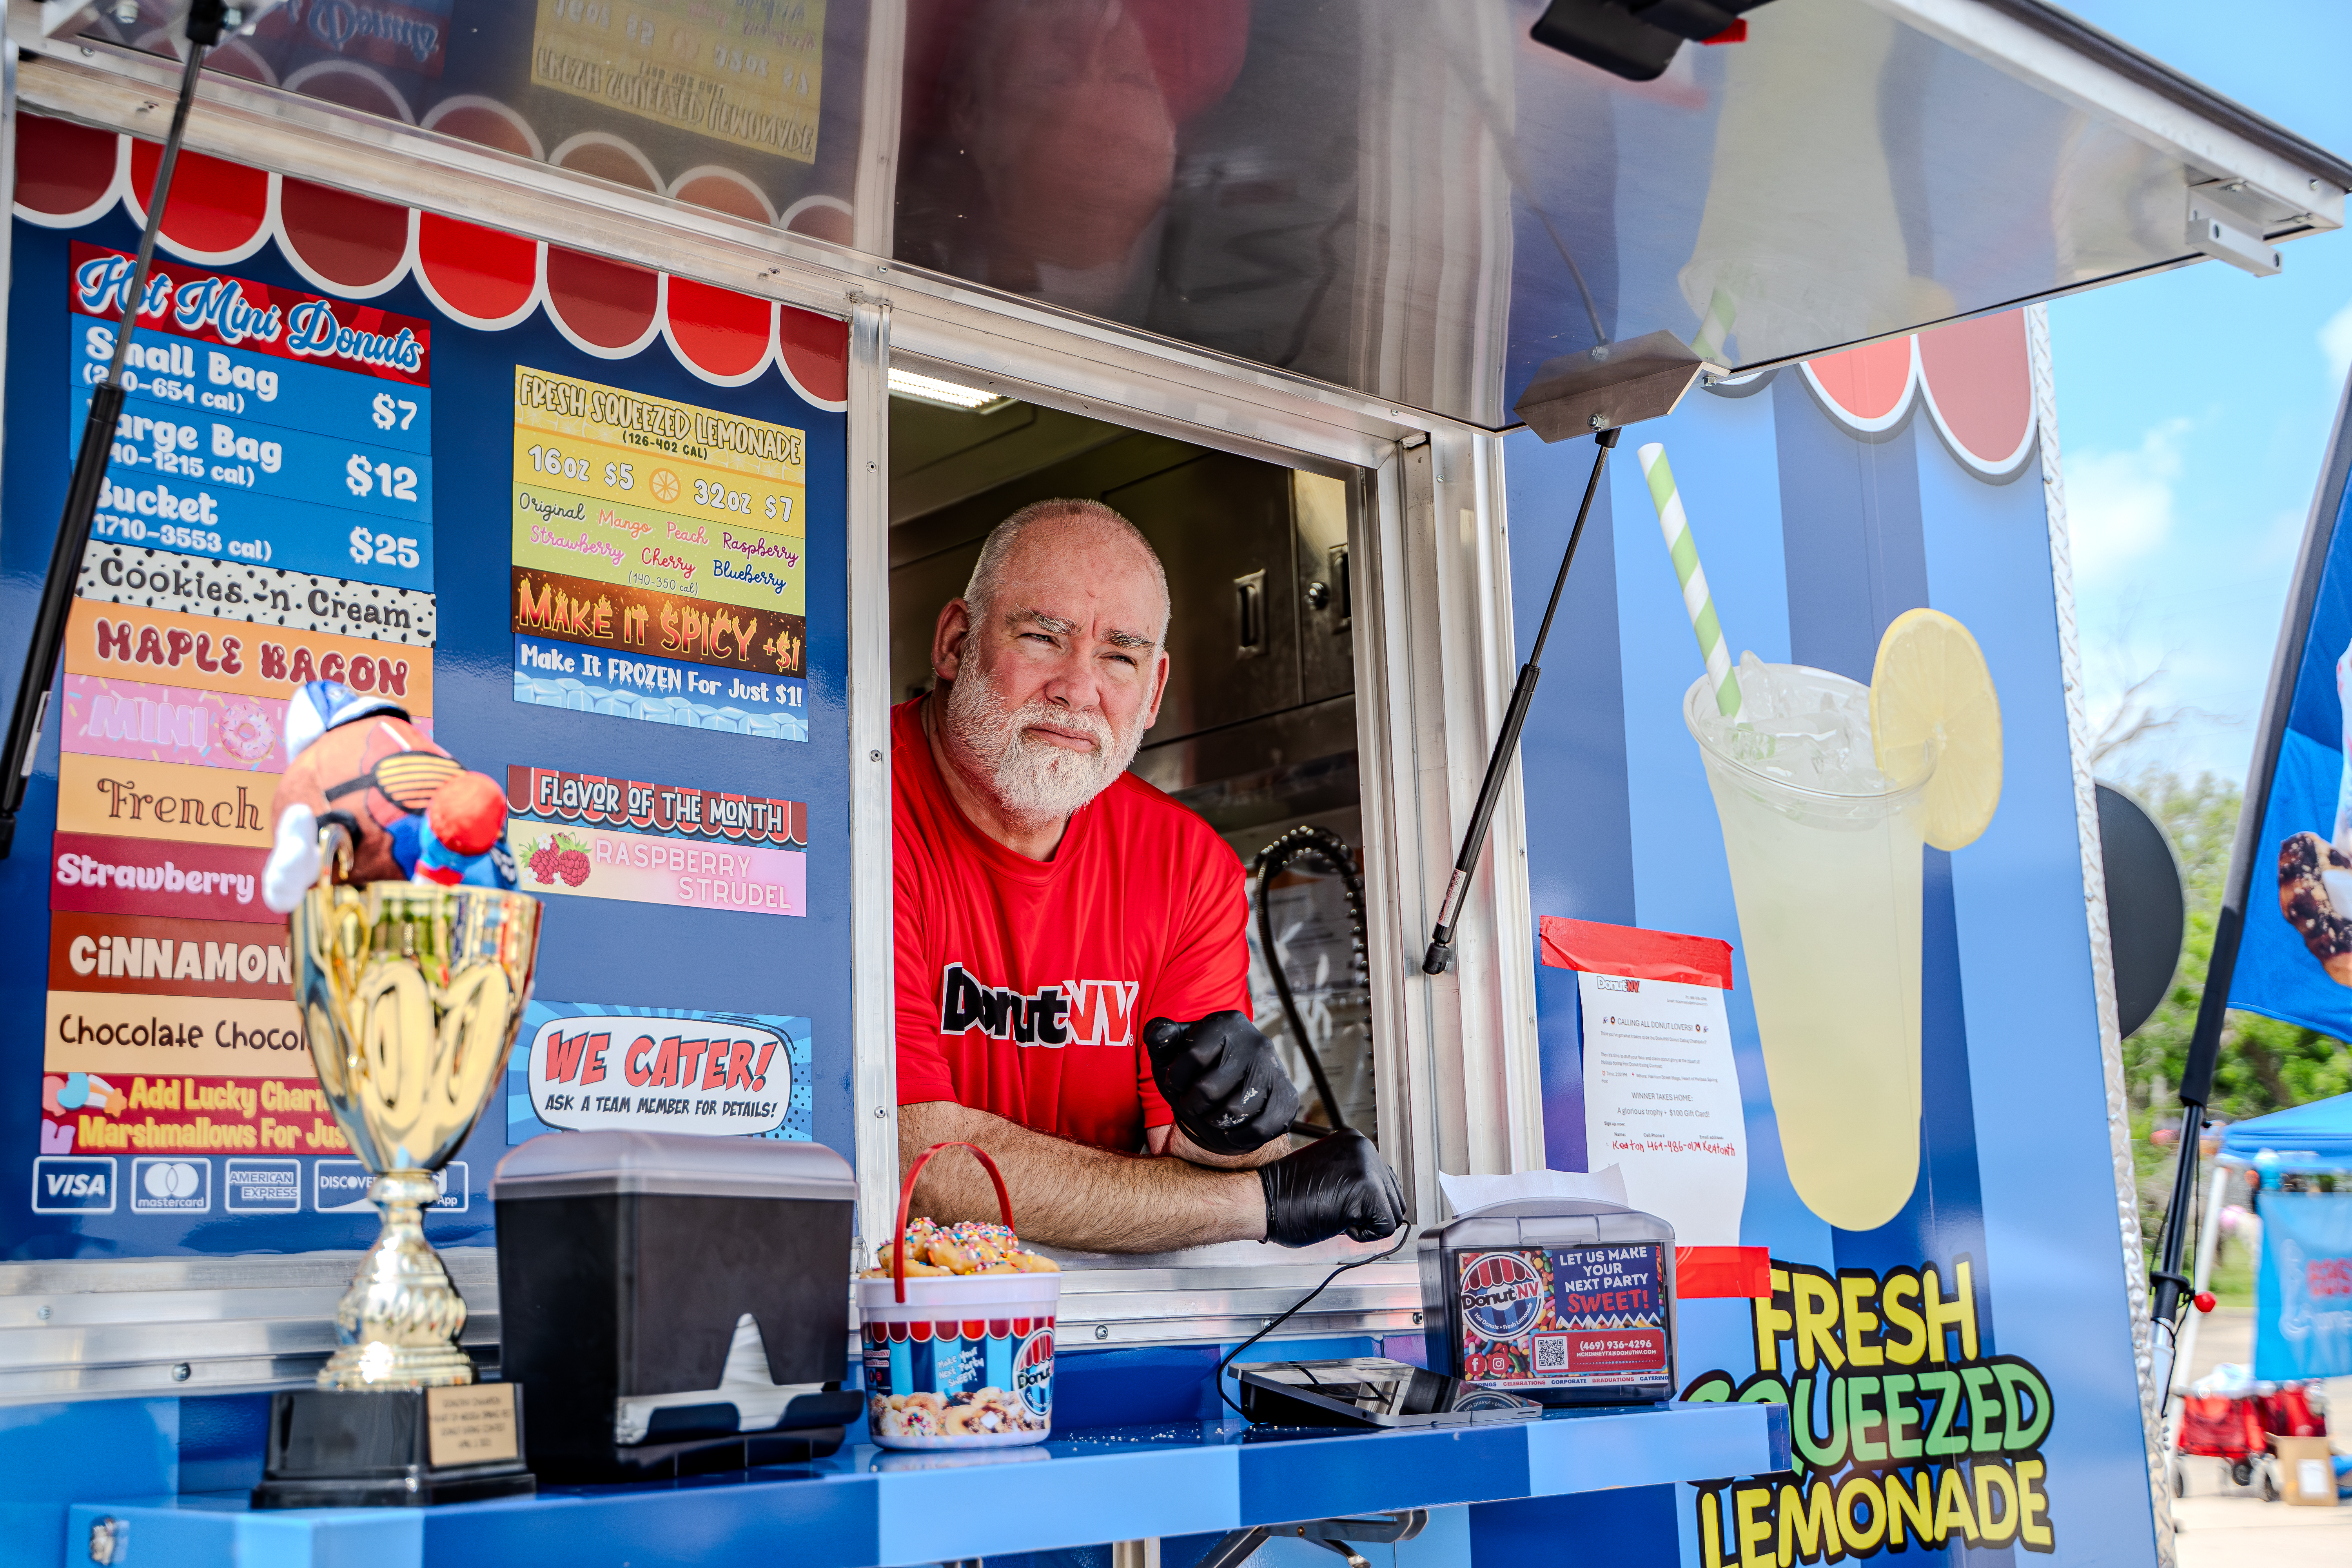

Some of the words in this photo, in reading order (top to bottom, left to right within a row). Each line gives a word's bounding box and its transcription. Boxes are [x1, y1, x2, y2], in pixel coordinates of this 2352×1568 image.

[75, 254, 173, 319] Ht
[176, 277, 283, 344] Mini
[287, 299, 425, 374] Donuts
[83, 362, 195, 404] (20-654
[201, 392, 245, 414] cal)
[208, 351, 278, 401] Bag
[372, 393, 418, 430] $7
[521, 374, 586, 418] FRESH
[591, 393, 691, 439] SQUEEZED
[696, 412, 801, 465] LEMONADE
[87, 399, 199, 453] arge
[212, 423, 283, 473] Bag
[623, 430, 678, 454] (126-402
[682, 444, 708, 460] CAL)
[110, 443, 205, 477] 40-1215
[211, 457, 255, 488] cal)
[346, 454, 418, 503] $12
[604, 461, 634, 490] $5
[765, 495, 793, 523] $7
[94, 513, 222, 553] 1710-3553
[227, 539, 273, 563] cal)
[349, 526, 420, 568] $25
[519, 492, 586, 522] Original
[599, 508, 652, 539] Mango
[667, 521, 708, 546] Peach
[723, 532, 799, 567] Raspberry
[530, 525, 625, 566] Strawberry
[642, 547, 696, 580] Cherry
[713, 559, 788, 595] Blueberry
[100, 557, 243, 604] Cookies
[307, 588, 412, 629] Cream
[629, 570, 676, 592] (140-350
[680, 582, 699, 596] cal)
[519, 577, 614, 640] MAKE
[624, 604, 649, 646] IT
[660, 600, 757, 662] SPICY
[762, 630, 801, 672] +$1
[94, 617, 243, 675] MAPLE
[260, 641, 409, 698] BACON
[521, 644, 575, 673] Make
[582, 655, 601, 678] It
[608, 659, 681, 693] FROZEN
[688, 671, 721, 696] For
[729, 678, 769, 704] Just
[775, 685, 802, 708] $1!
[88, 695, 209, 747] MINI
[97, 778, 265, 831] French
[628, 786, 653, 817] OF
[661, 791, 701, 823] THE
[710, 798, 783, 833] MONTH
[595, 839, 751, 878] RASPBERRY
[57, 853, 255, 904] Strawberry
[678, 877, 791, 909] STRUDEL
[1597, 976, 1640, 993] DonutNV
[59, 1013, 204, 1049] Chocolate
[215, 1020, 307, 1051] Chocol
[1618, 1018, 1639, 1026] CALLING
[1671, 1023, 1693, 1031] LOVERS!
[545, 1028, 611, 1086] WE
[624, 1034, 777, 1092] CATER!
[128, 1077, 177, 1109] Add
[184, 1079, 256, 1118] Lucky
[544, 1094, 574, 1111] ASK
[581, 1095, 590, 1111] A
[596, 1096, 631, 1114] TEAM
[637, 1098, 690, 1116] MEMBER
[695, 1098, 717, 1116] FOR
[722, 1101, 776, 1118] DETAILS!
[1622, 1107, 1644, 1116] glorious
[78, 1116, 257, 1148] Marshmallows
[261, 1118, 302, 1149] For
[306, 1118, 348, 1149] Jus
[45, 1174, 105, 1196] VISA
[229, 1171, 294, 1186] AMERICAN
[242, 1186, 298, 1200] EXPRESS
[320, 1176, 377, 1189] DISCOVE
[137, 1196, 204, 1208] mastercard
[437, 1195, 457, 1206] App
[1560, 1253, 1582, 1266] LET
[1586, 1251, 1604, 1263] US
[1608, 1247, 1647, 1261] MAKE
[1583, 1263, 1623, 1276] YOUR
[1461, 1281, 1539, 1310] DonutNV
[1565, 1278, 1599, 1292] NEXT
[1604, 1273, 1648, 1288] PARTY
[1568, 1289, 1649, 1313] SWEET!
[1482, 1319, 1499, 1330] Donuts
[1515, 1302, 1533, 1324] Lemonade
[1756, 1260, 1978, 1371] FRESH
[938, 1355, 957, 1369] Make
[959, 1347, 978, 1363] Your
[1580, 1340, 1604, 1351] (469)
[1607, 1339, 1652, 1349] 936-4296
[938, 1366, 956, 1379] Next
[958, 1357, 984, 1372] Party
[948, 1368, 978, 1387] SWEET!
[1701, 1459, 2051, 1568] LEMONADE
